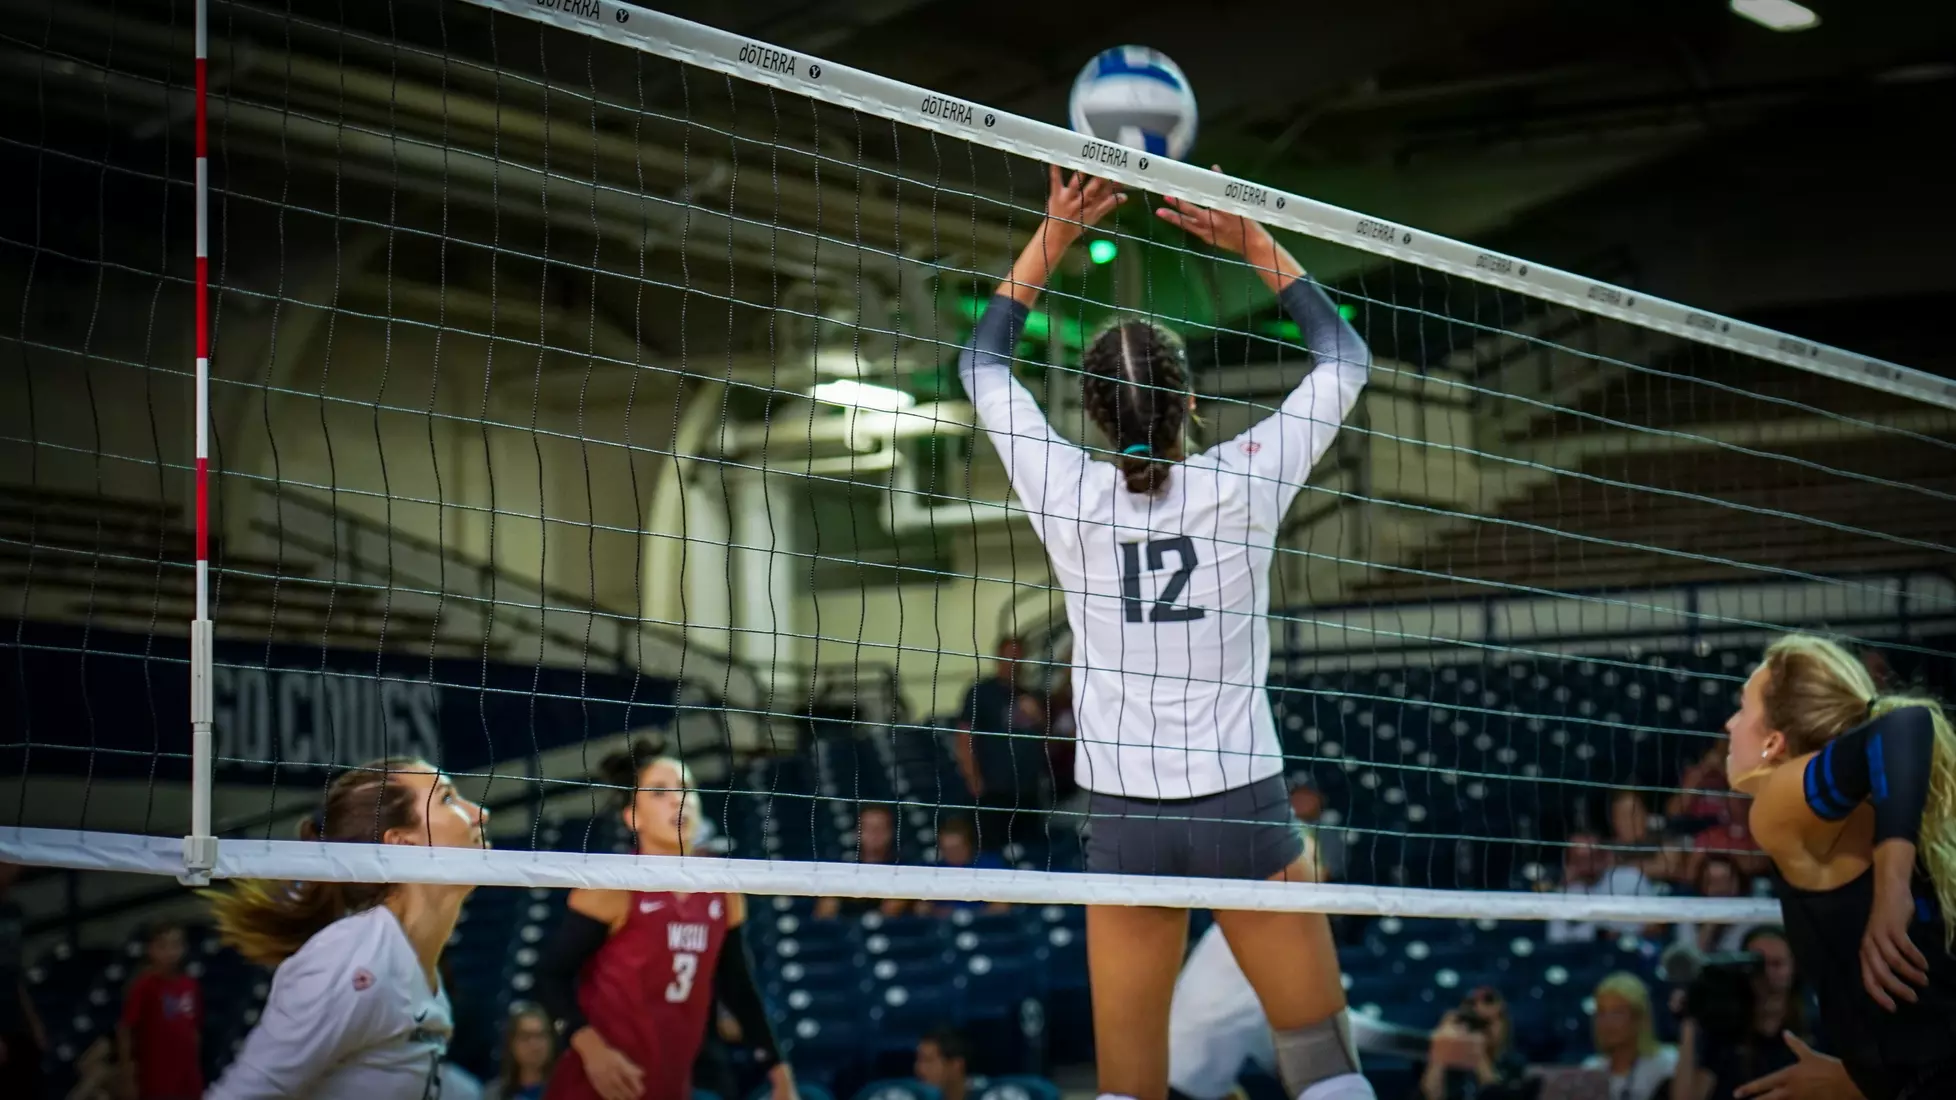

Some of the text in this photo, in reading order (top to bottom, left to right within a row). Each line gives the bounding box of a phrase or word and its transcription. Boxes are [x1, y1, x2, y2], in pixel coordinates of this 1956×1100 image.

[537, 0, 600, 19] ERRA
[739, 43, 797, 75] dōTERRA
[921, 94, 973, 125] dōTERRA
[1120, 535, 1205, 623] 12
[664, 952, 698, 1004] 3
